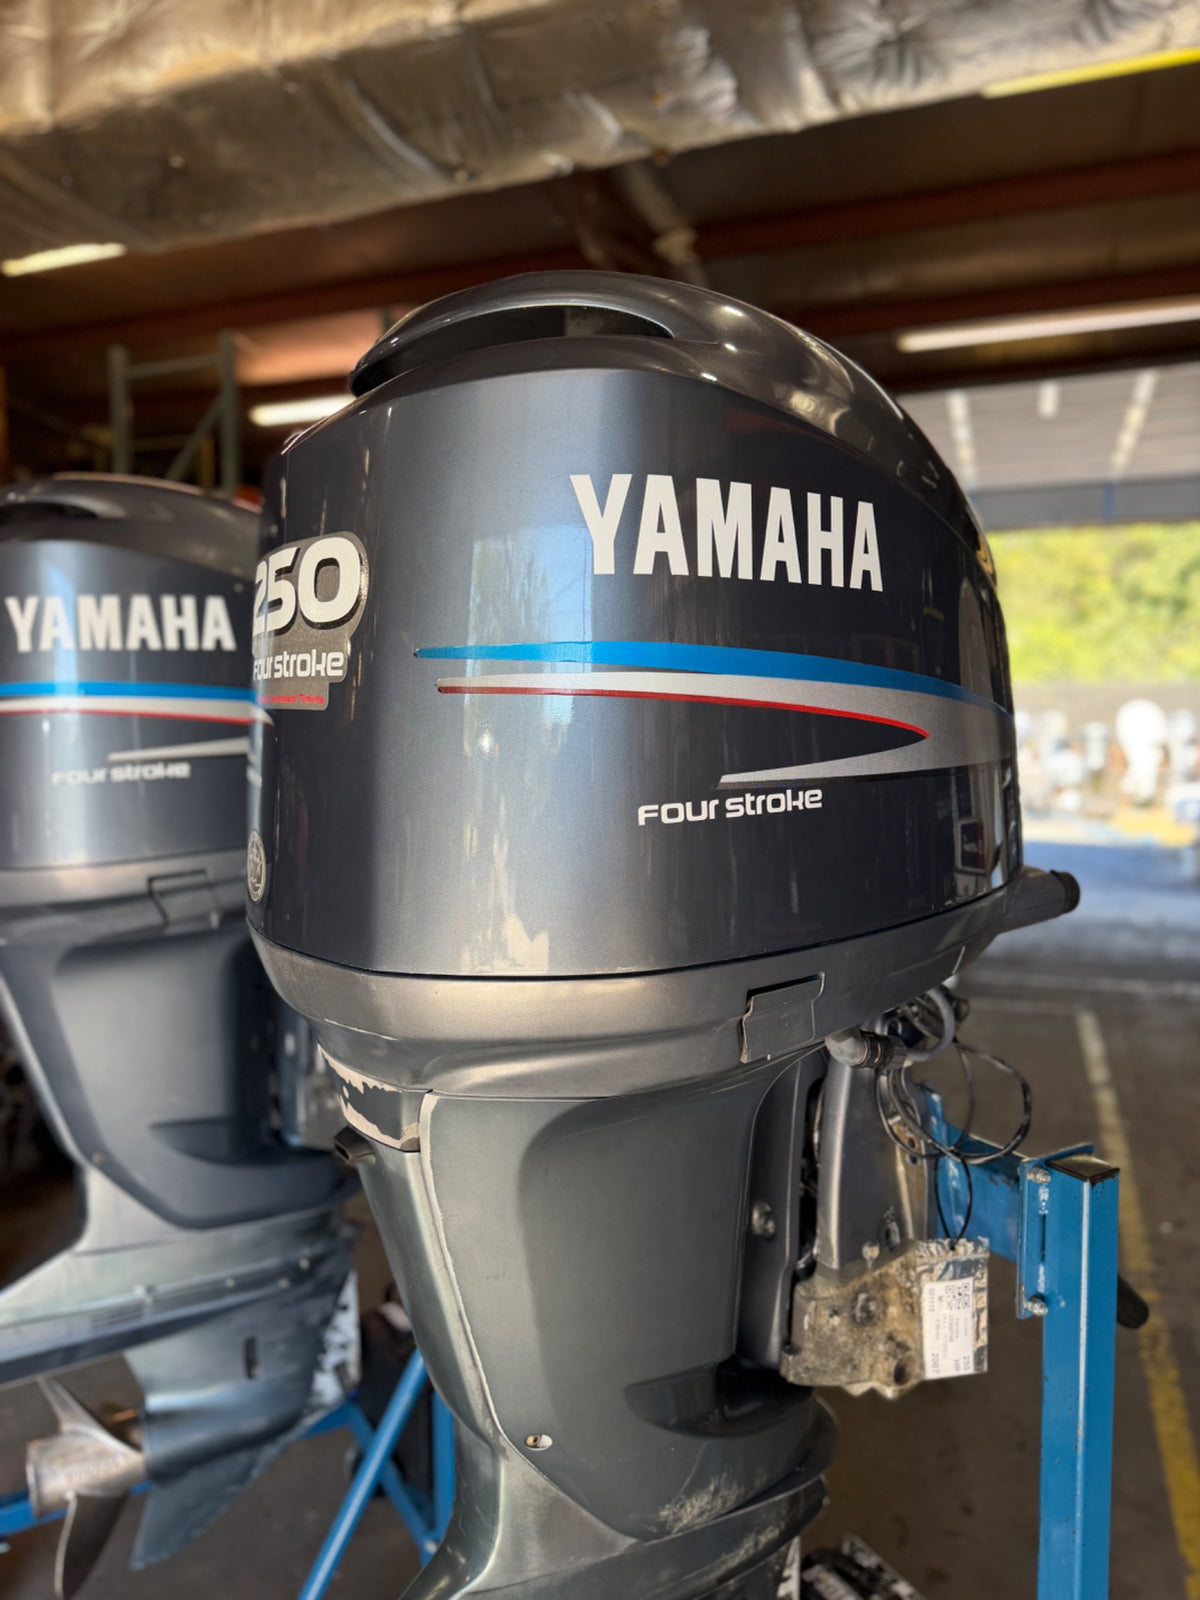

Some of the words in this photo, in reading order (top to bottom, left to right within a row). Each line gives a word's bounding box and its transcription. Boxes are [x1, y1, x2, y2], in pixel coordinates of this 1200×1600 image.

[570, 473, 883, 592] YAMAHA
[5, 594, 237, 653] YAMAHA
[253, 537, 361, 636] 250
